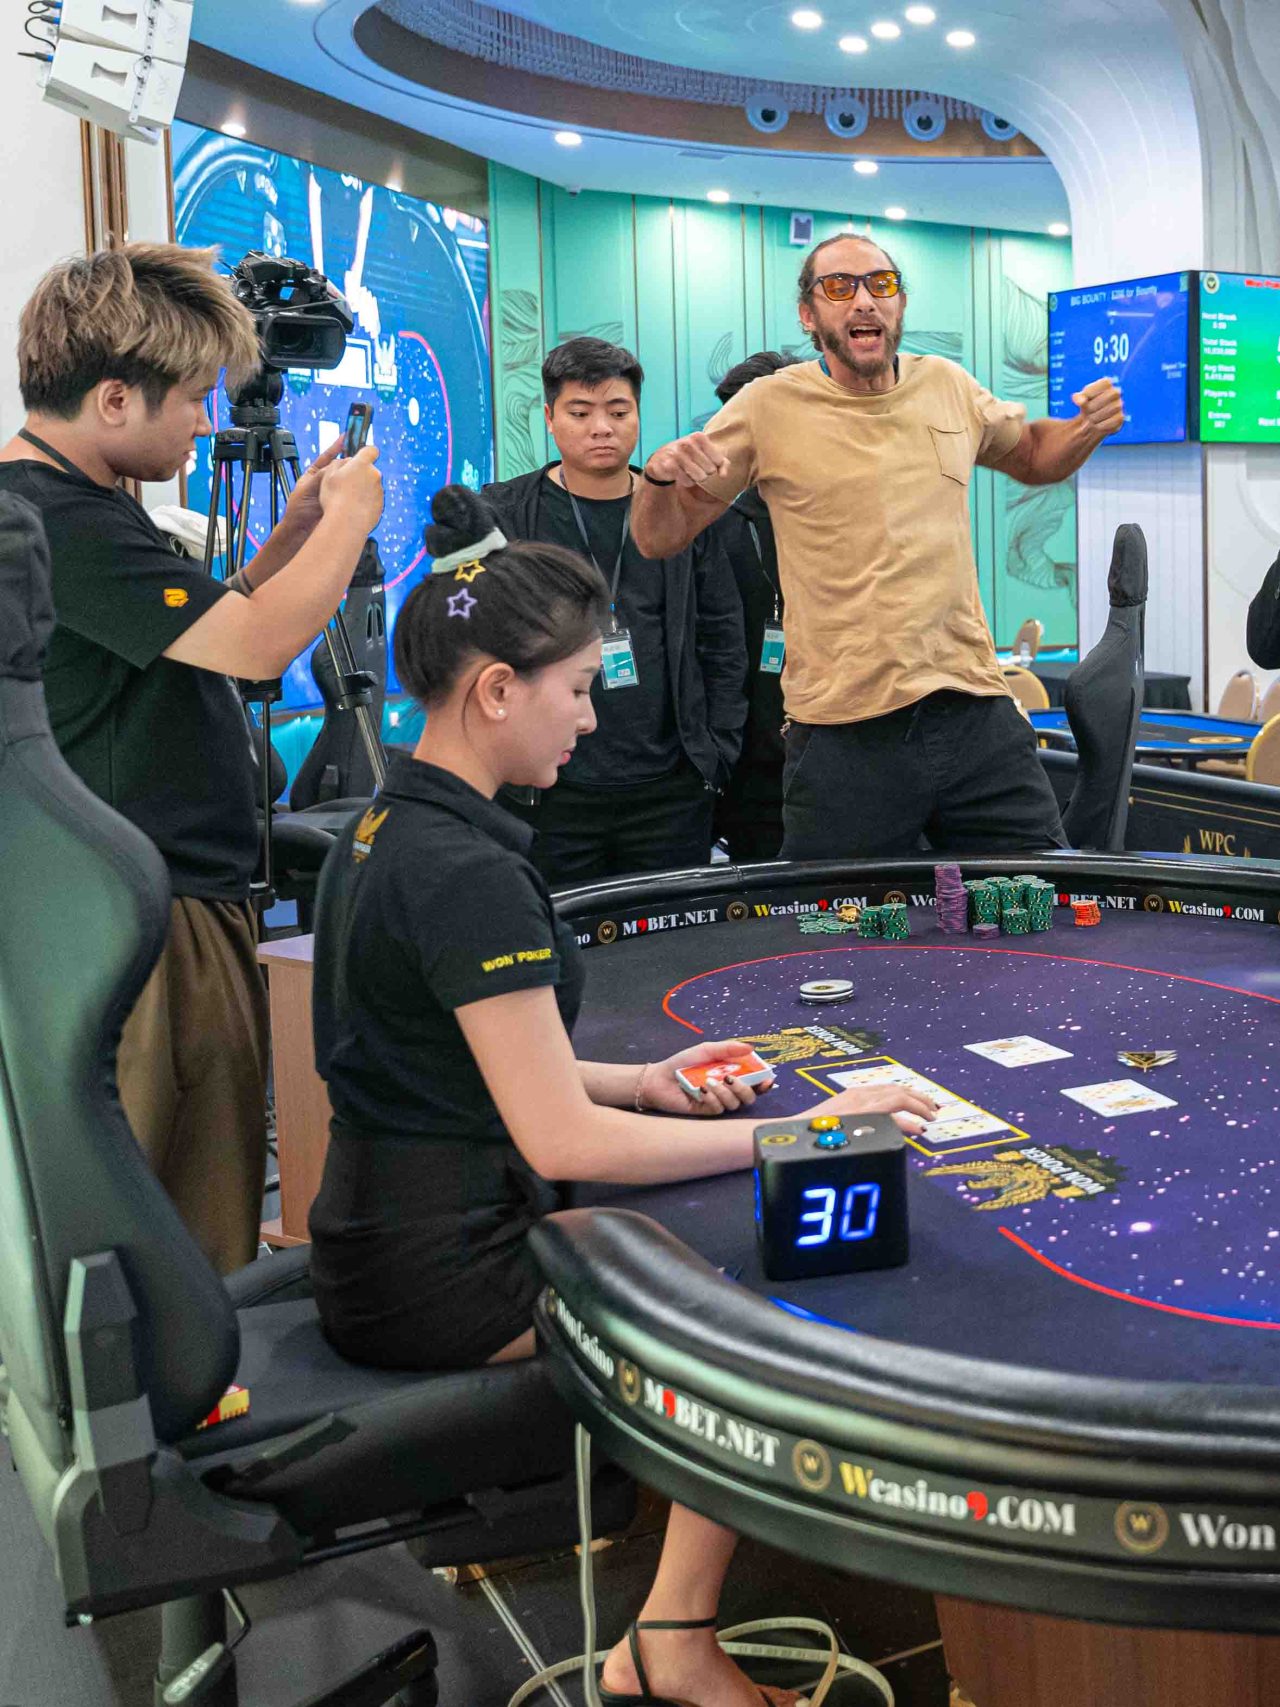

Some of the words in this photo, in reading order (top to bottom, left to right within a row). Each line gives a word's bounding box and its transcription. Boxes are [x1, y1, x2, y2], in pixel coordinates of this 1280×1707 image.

[1093, 332, 1130, 365] 9:30
[1199, 829, 1236, 856] WPC
[911, 895, 937, 906] Wo
[1168, 900, 1265, 922] Wcasino9.COM
[622, 908, 718, 936] M9BET.NET
[481, 954, 514, 972] WON
[517, 947, 552, 963] POKER
[1020, 1147, 1073, 1175] POKER
[1060, 1171, 1106, 1195] WON
[796, 1181, 882, 1249] 30
[643, 1377, 780, 1468] M9BET.NET
[839, 1460, 1078, 1537] Wcasino9.COM
[1180, 1513, 1276, 1552] Won
